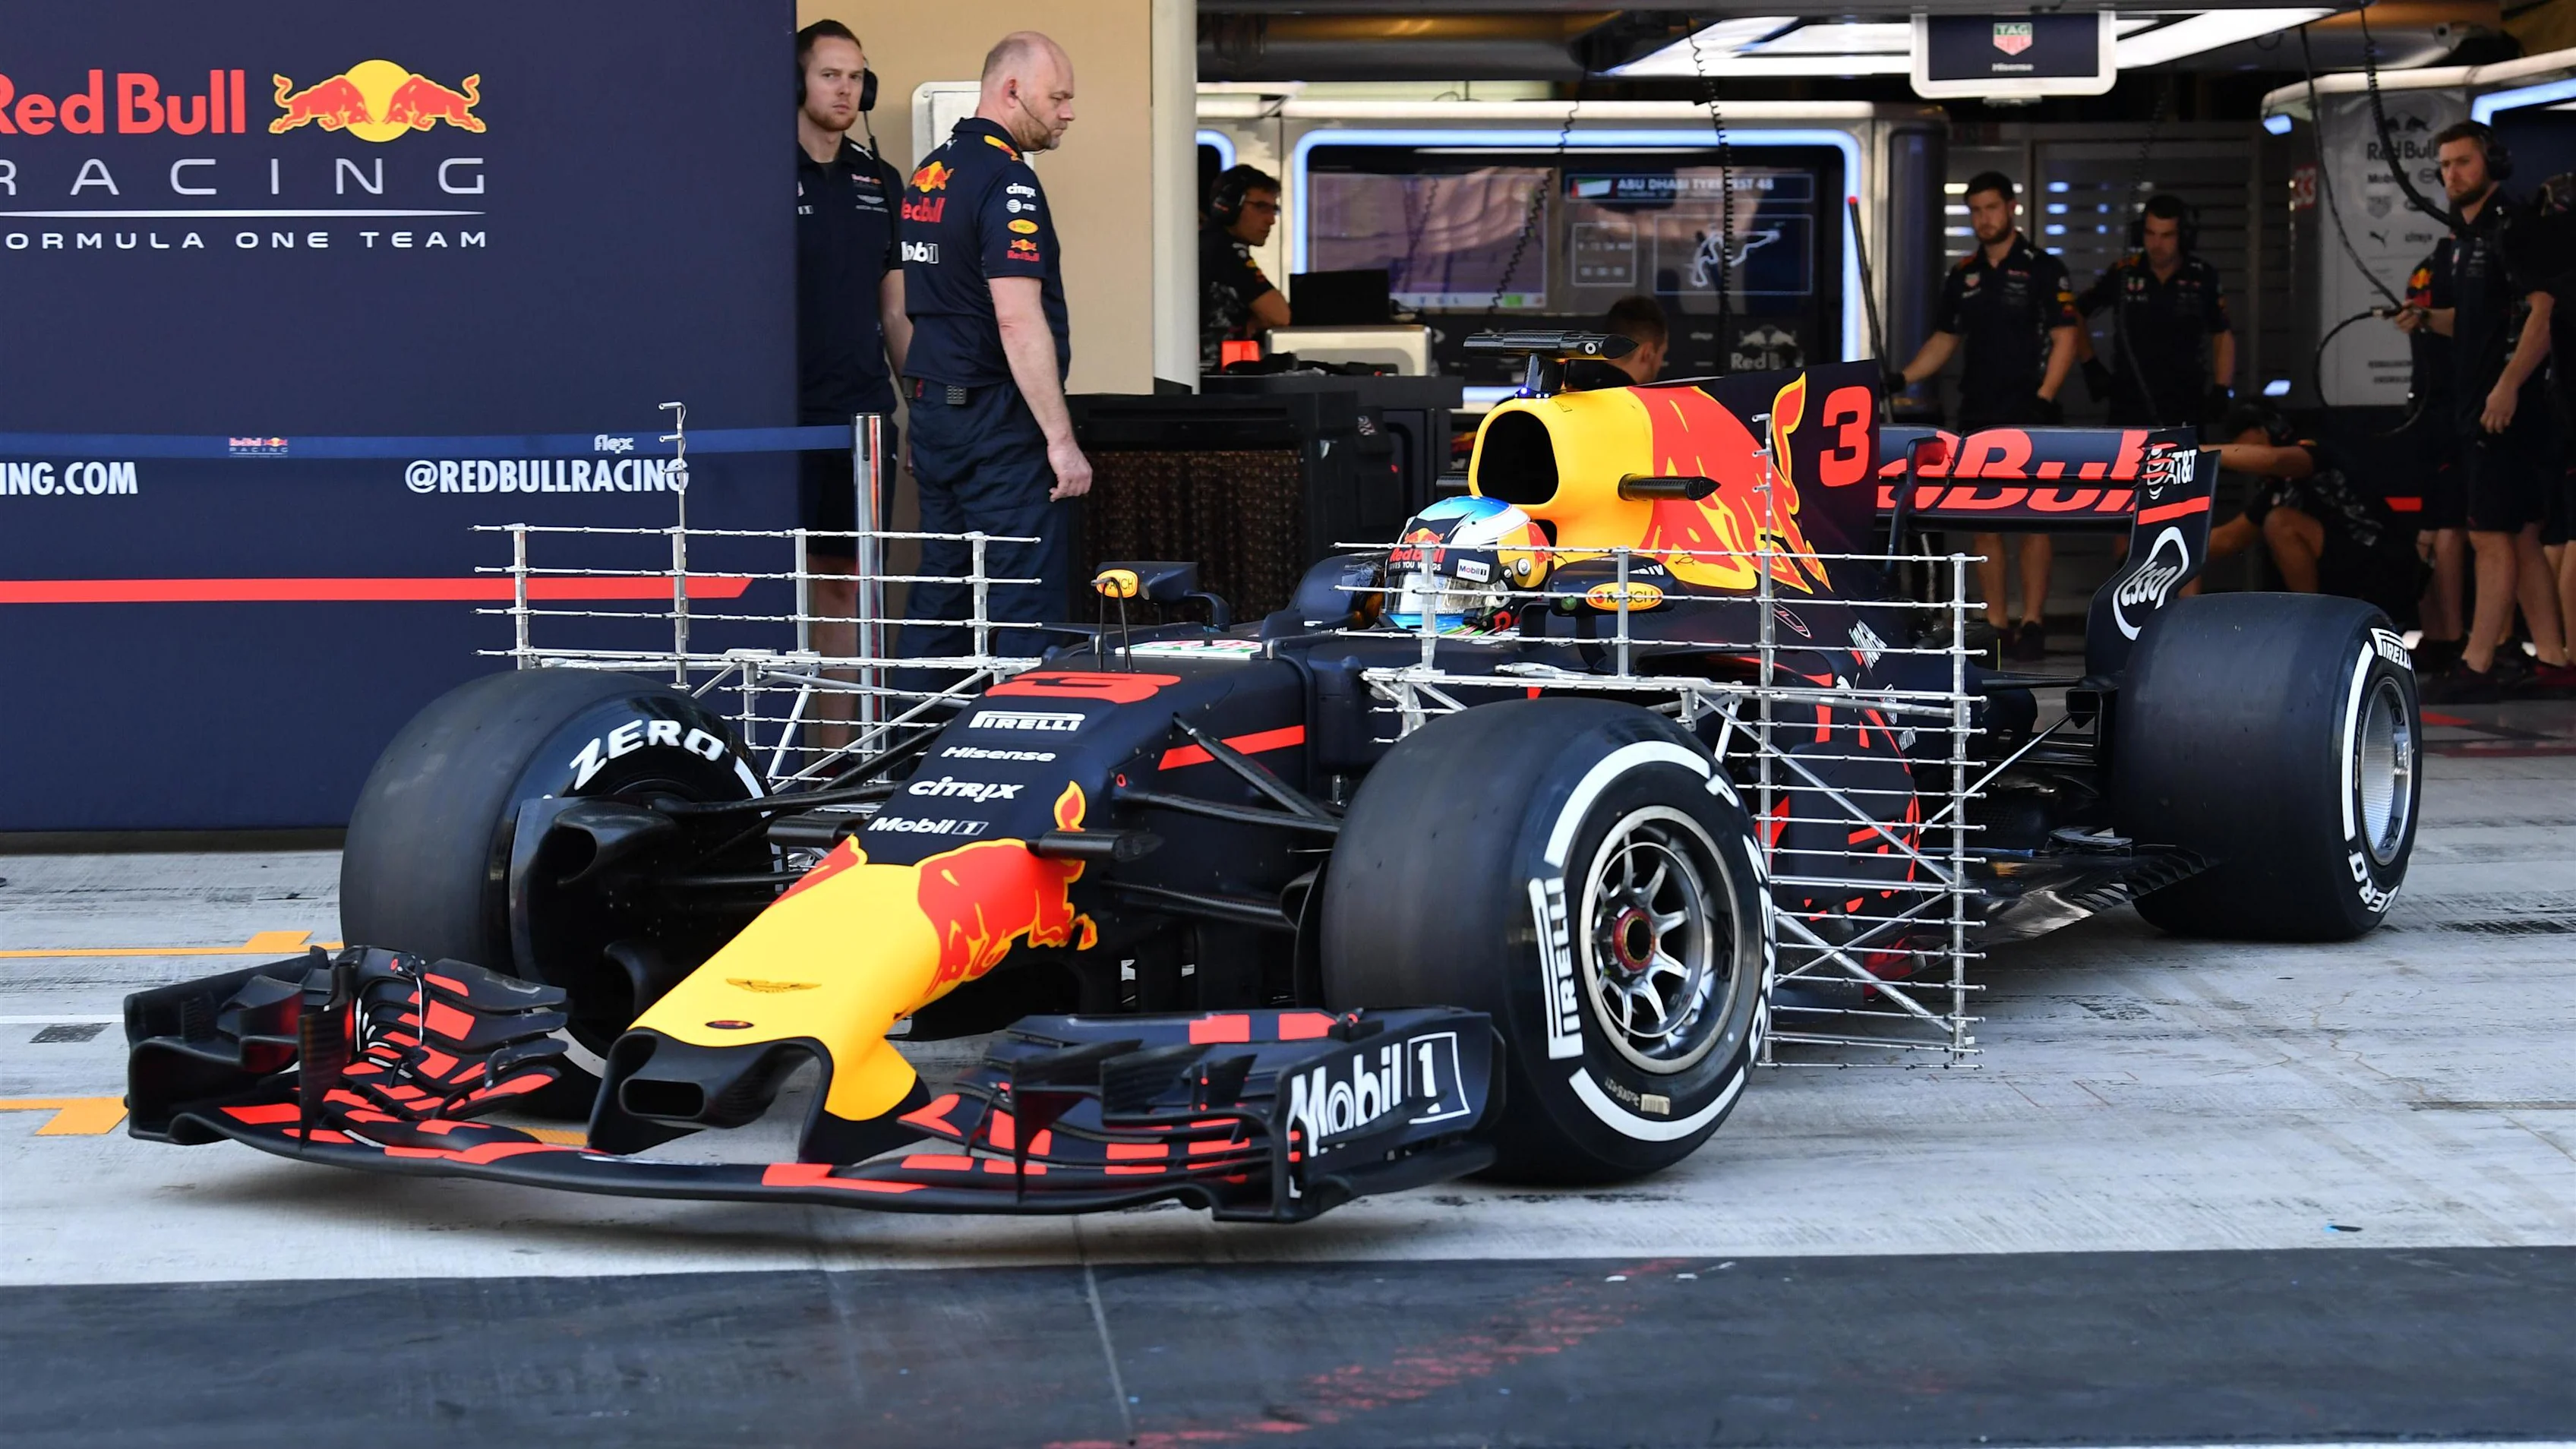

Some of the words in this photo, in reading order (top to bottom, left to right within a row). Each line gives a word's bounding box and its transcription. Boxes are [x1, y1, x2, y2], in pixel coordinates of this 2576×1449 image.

[117, 69, 246, 135] Bull
[1617, 178, 1643, 190] ABU
[1724, 178, 1754, 190] EST
[235, 232, 328, 248] ONE
[360, 231, 486, 248] TEAM
[1819, 386, 1872, 487] 3
[0, 461, 138, 495] ING.COM
[405, 459, 690, 494] @REDBULLRACING
[2164, 449, 2197, 486] AT&T
[1412, 547, 1446, 564] Bll
[1458, 564, 1480, 576] Mobil
[968, 710, 1086, 732] PIRELLI
[569, 718, 730, 791] ZERO
[940, 746, 1057, 762] Hisense
[867, 816, 958, 835] Mobil
[1528, 876, 1585, 1061] PIRELLI
[1286, 1043, 1403, 1157] Mobil
